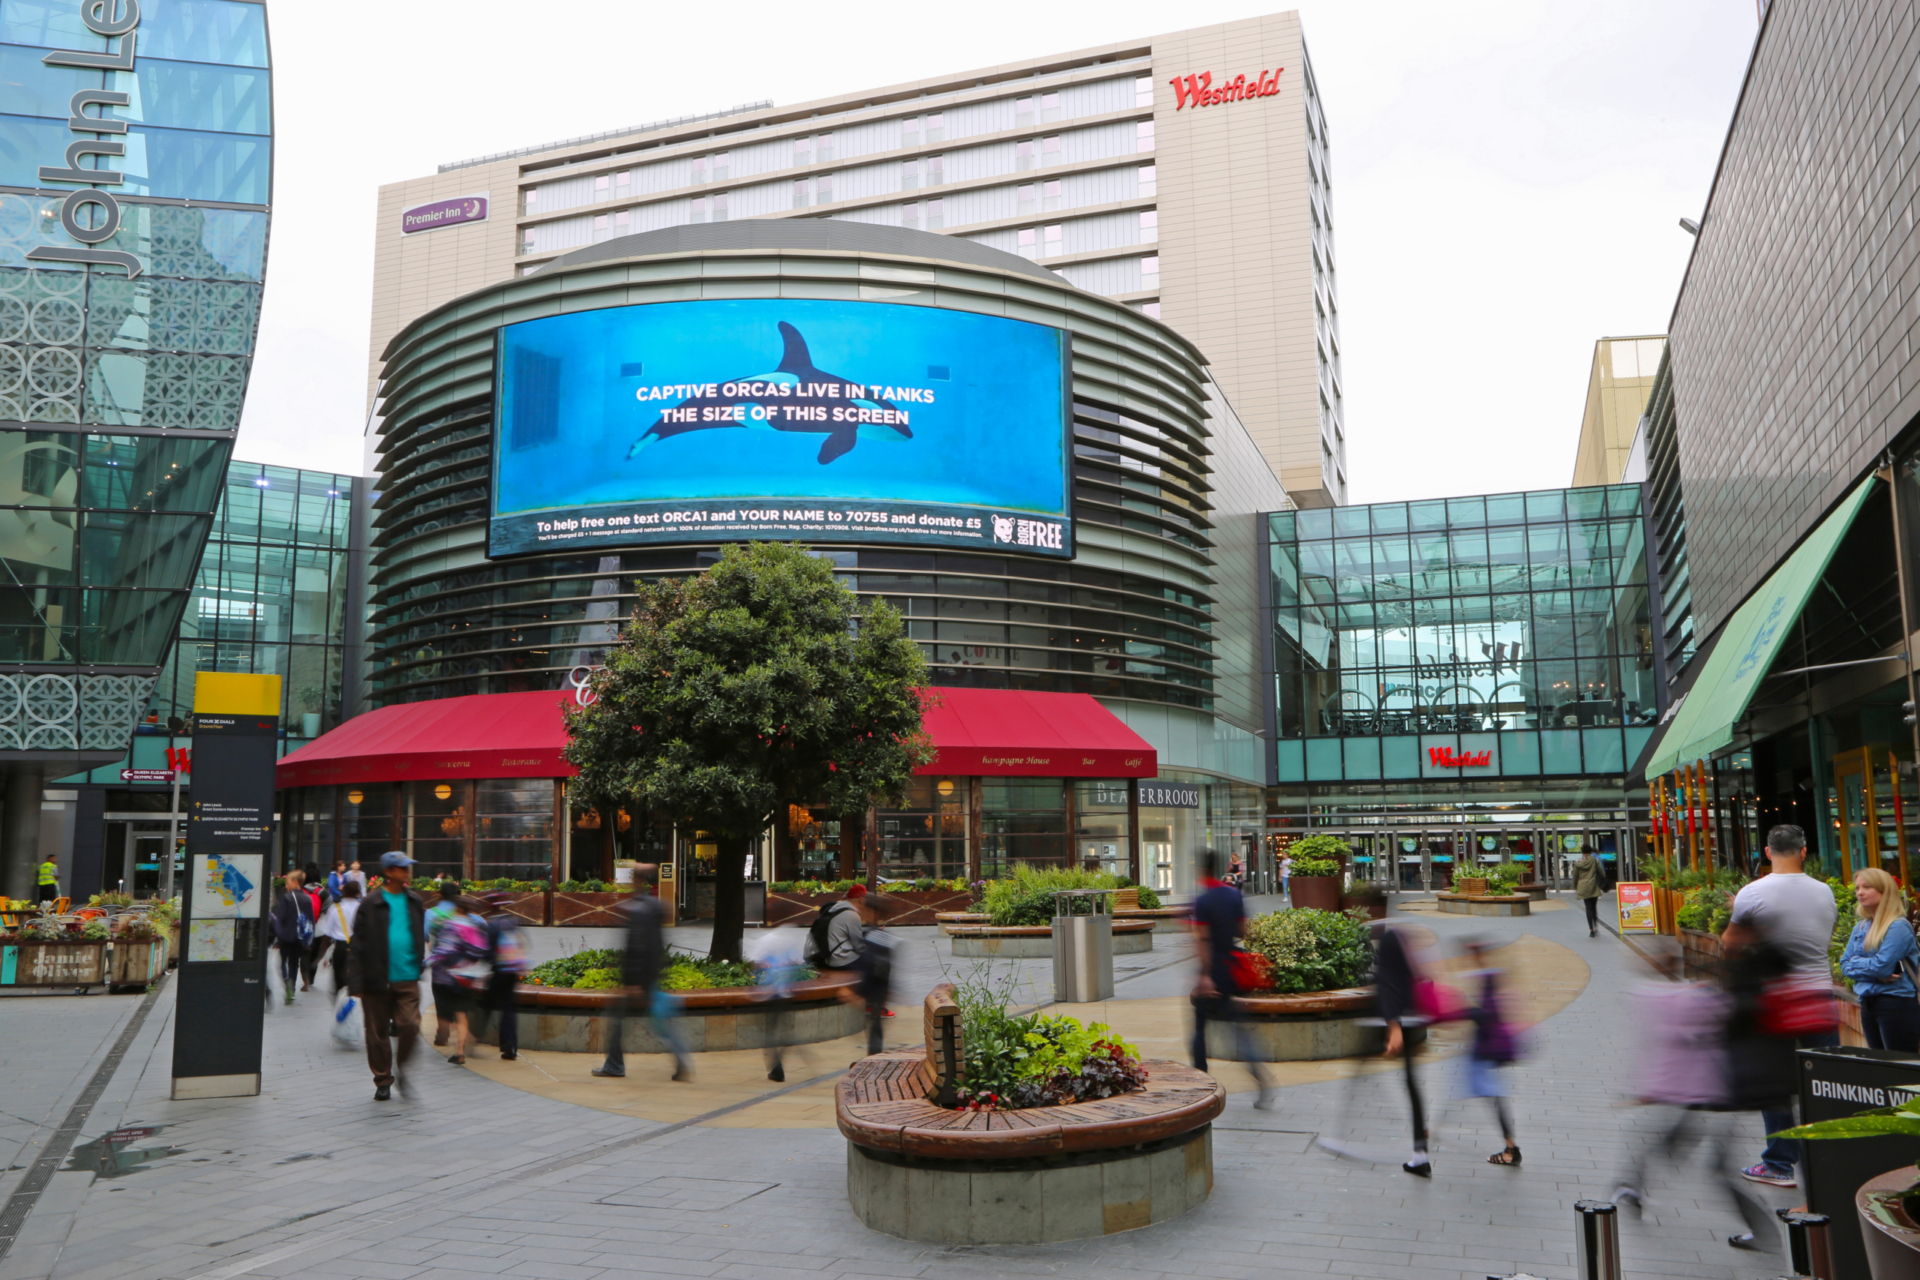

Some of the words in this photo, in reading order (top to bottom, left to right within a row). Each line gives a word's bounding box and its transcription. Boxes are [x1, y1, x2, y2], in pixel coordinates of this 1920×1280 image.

[1169, 67, 1284, 111] Westfield
[25, 88, 144, 280] John
[406, 211, 444, 226] Premier
[446, 208, 460, 218] Inn
[636, 383, 718, 401] CAPTIVE
[722, 383, 791, 397] ORCAS
[796, 383, 839, 398] LIVE
[845, 384, 865, 399] IN
[870, 385, 935, 404] TANKS
[660, 407, 697, 423] THE
[702, 407, 745, 421] SIZE
[751, 406, 777, 420] OF
[783, 406, 827, 421] THIS
[832, 407, 909, 425] SCREEN
[537, 522, 551, 532] To
[554, 519, 578, 531] help
[581, 517, 605, 528] free
[608, 516, 630, 526] one
[634, 513, 659, 524] text
[662, 511, 707, 522] ORCA1
[711, 510, 736, 521] and
[739, 510, 779, 520] YOUR
[783, 510, 824, 520] NAME
[828, 510, 842, 520] to
[846, 511, 888, 522] 70755
[891, 514, 915, 524] and
[919, 514, 963, 527] donate
[966, 518, 981, 528] £5
[1018, 519, 1029, 545] BORN
[1029, 520, 1063, 549] FREE
[963, 646, 1020, 661] COFFE
[501, 758, 542, 766] Ristorante
[982, 755, 1024, 766] hampagne
[1026, 756, 1050, 765] House
[1082, 757, 1096, 765] Bar
[1427, 746, 1492, 767] Westfield
[1097, 782, 1198, 806] BEAERBROOKS
[33, 951, 93, 964] Jamie
[32, 964, 95, 978] Oliver
[1812, 1079, 1885, 1106] DRINKING
[1888, 1090, 1920, 1107] WA
